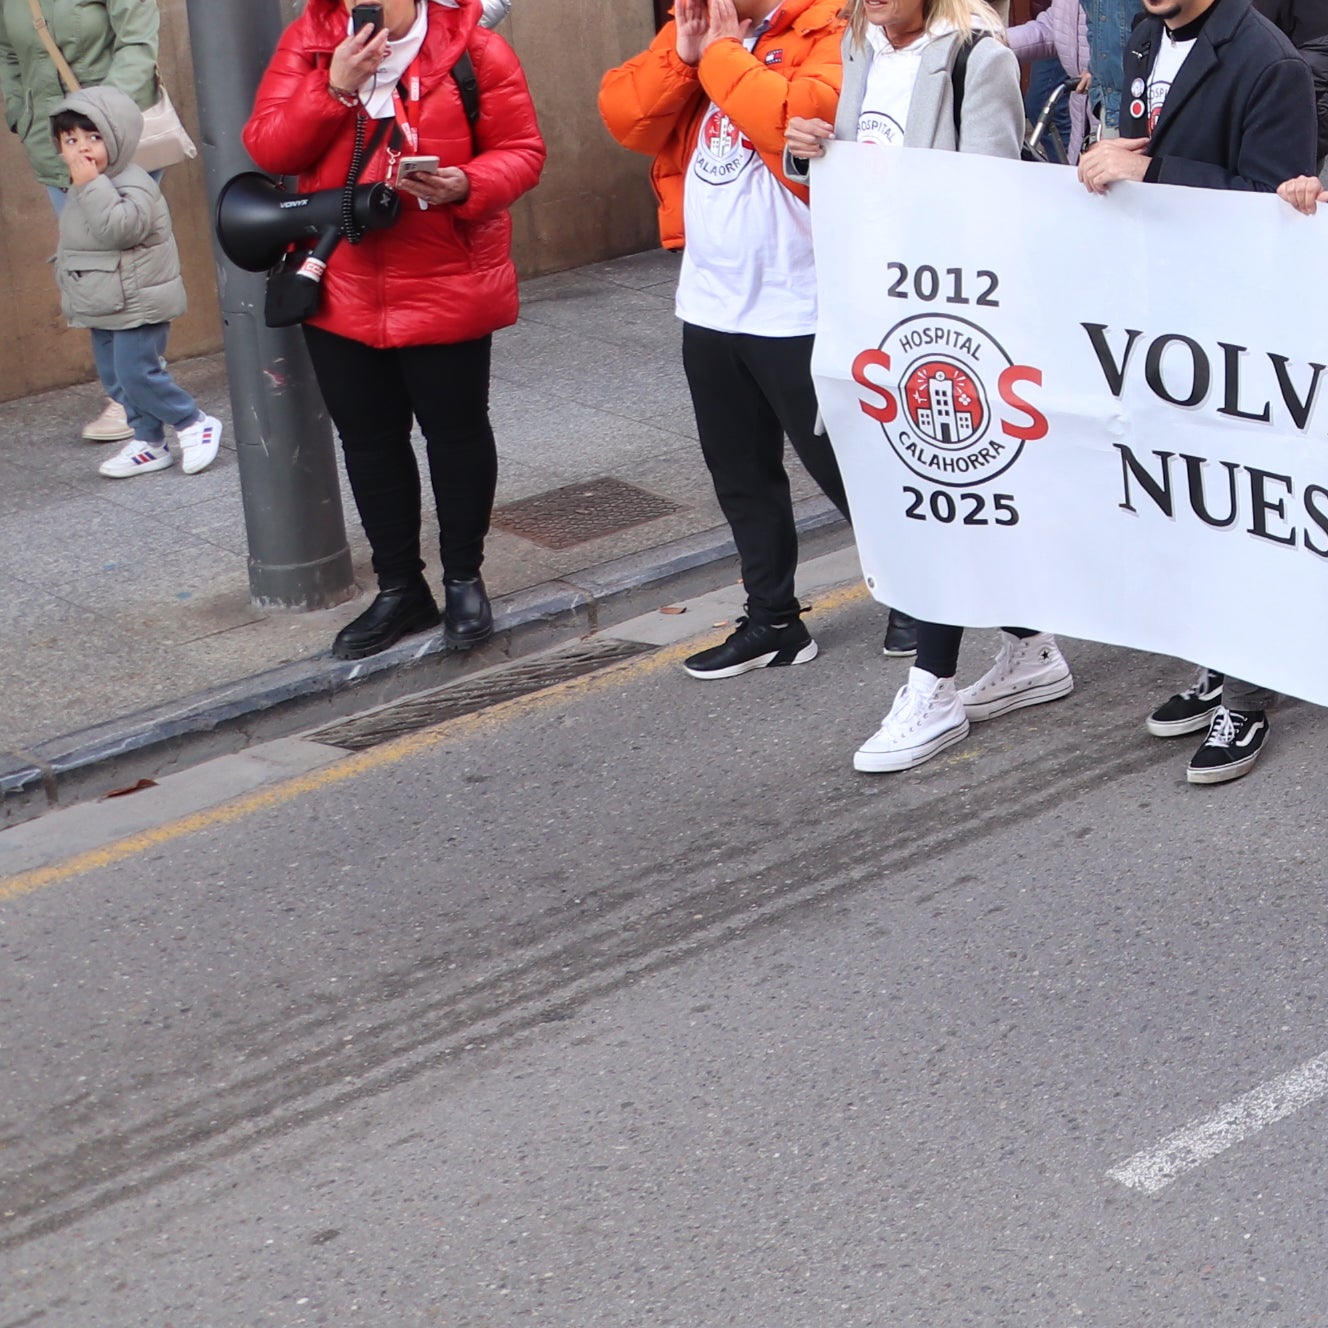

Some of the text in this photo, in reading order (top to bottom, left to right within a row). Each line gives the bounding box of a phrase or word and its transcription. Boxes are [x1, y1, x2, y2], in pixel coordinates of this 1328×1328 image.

[280, 199, 309, 208] VONYX
[887, 261, 1000, 308] 2012
[899, 327, 981, 360] HOSPITAL
[899, 431, 1006, 473] CALAHORRA
[902, 485, 1020, 526] 2025
